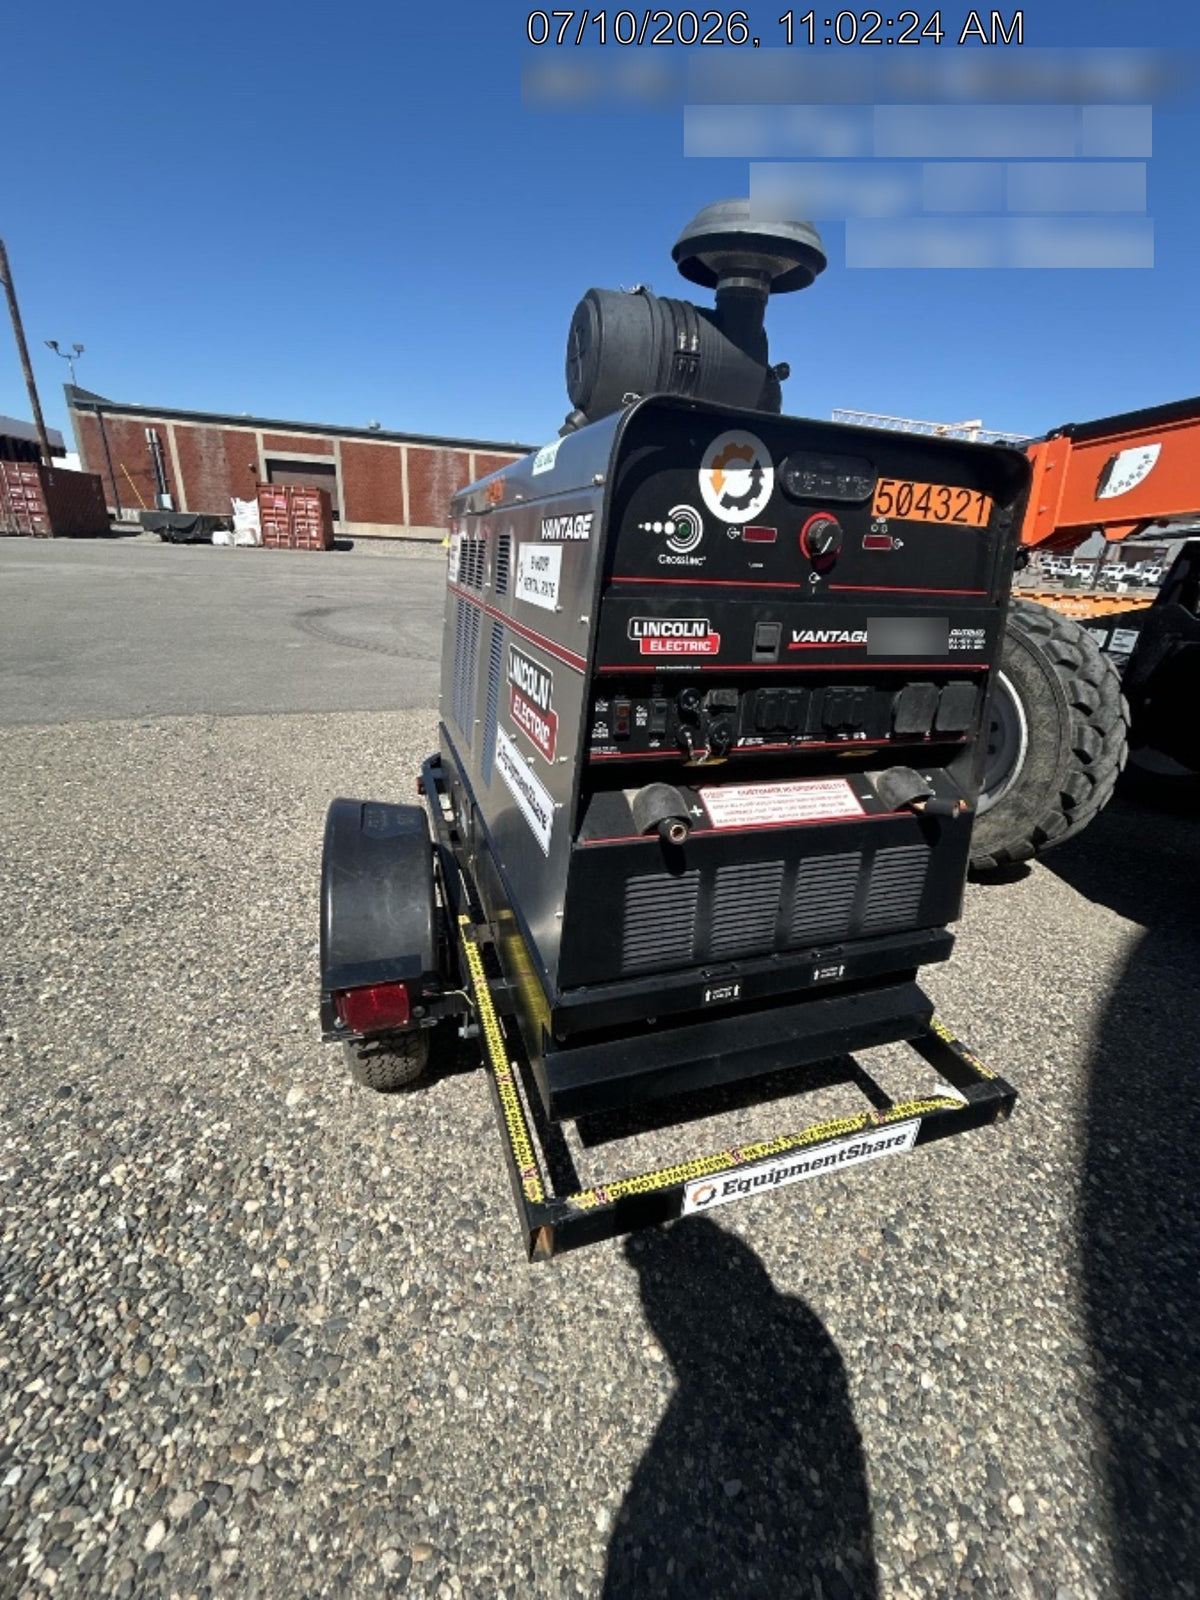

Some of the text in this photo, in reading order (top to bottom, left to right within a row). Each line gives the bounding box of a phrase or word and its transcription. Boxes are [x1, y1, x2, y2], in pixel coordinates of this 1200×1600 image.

[875, 481, 987, 524] 504321
[542, 513, 594, 540] VANTAGE
[633, 622, 705, 637] LINCOLN
[650, 641, 711, 652] ELECTRIC
[509, 652, 549, 711] LINCOLN
[513, 695, 550, 750] ELECTRIC
[609, 1156, 732, 1198] DO NOT STAND HERE
[721, 1132, 908, 1198] EquipmentShare
